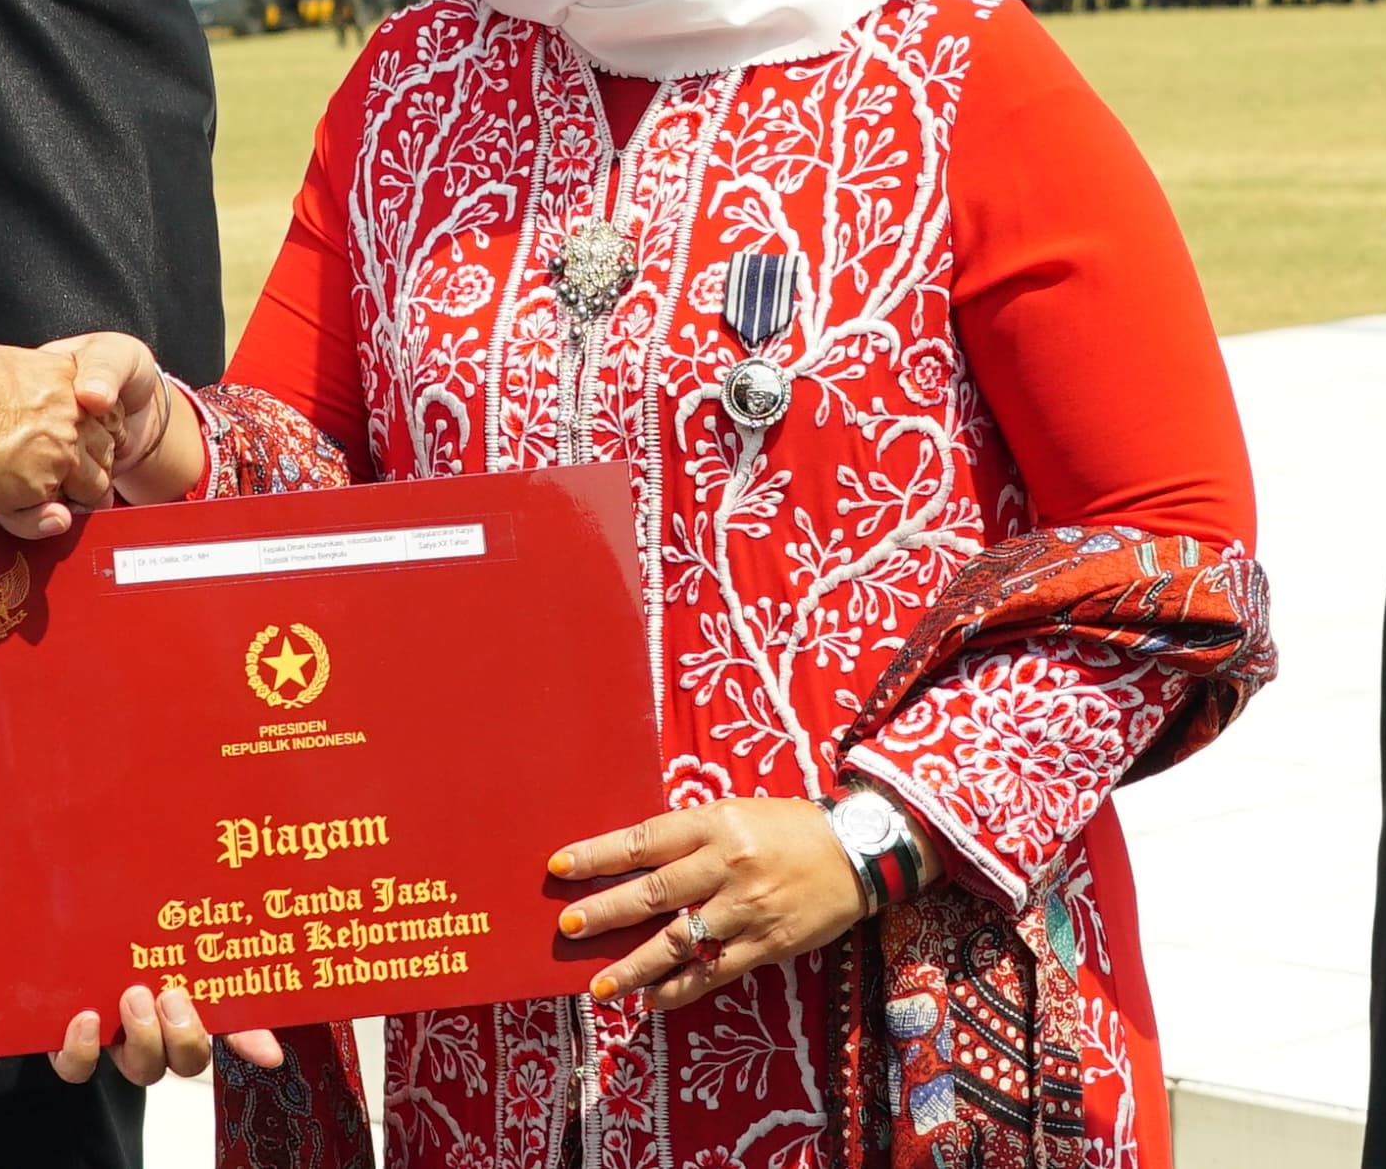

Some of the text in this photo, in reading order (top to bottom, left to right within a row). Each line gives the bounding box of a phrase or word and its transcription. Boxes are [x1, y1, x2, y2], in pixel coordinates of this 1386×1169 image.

[221, 731, 367, 757] REPUBLIK INDONESIA
[259, 719, 327, 738] PRESIDEN
[215, 815, 390, 868] Piagam
[157, 876, 458, 930] Gelar, Tanda Jasa,
[130, 910, 491, 969] dan Tanda Kehormatan
[312, 945, 469, 990] Indonesia
